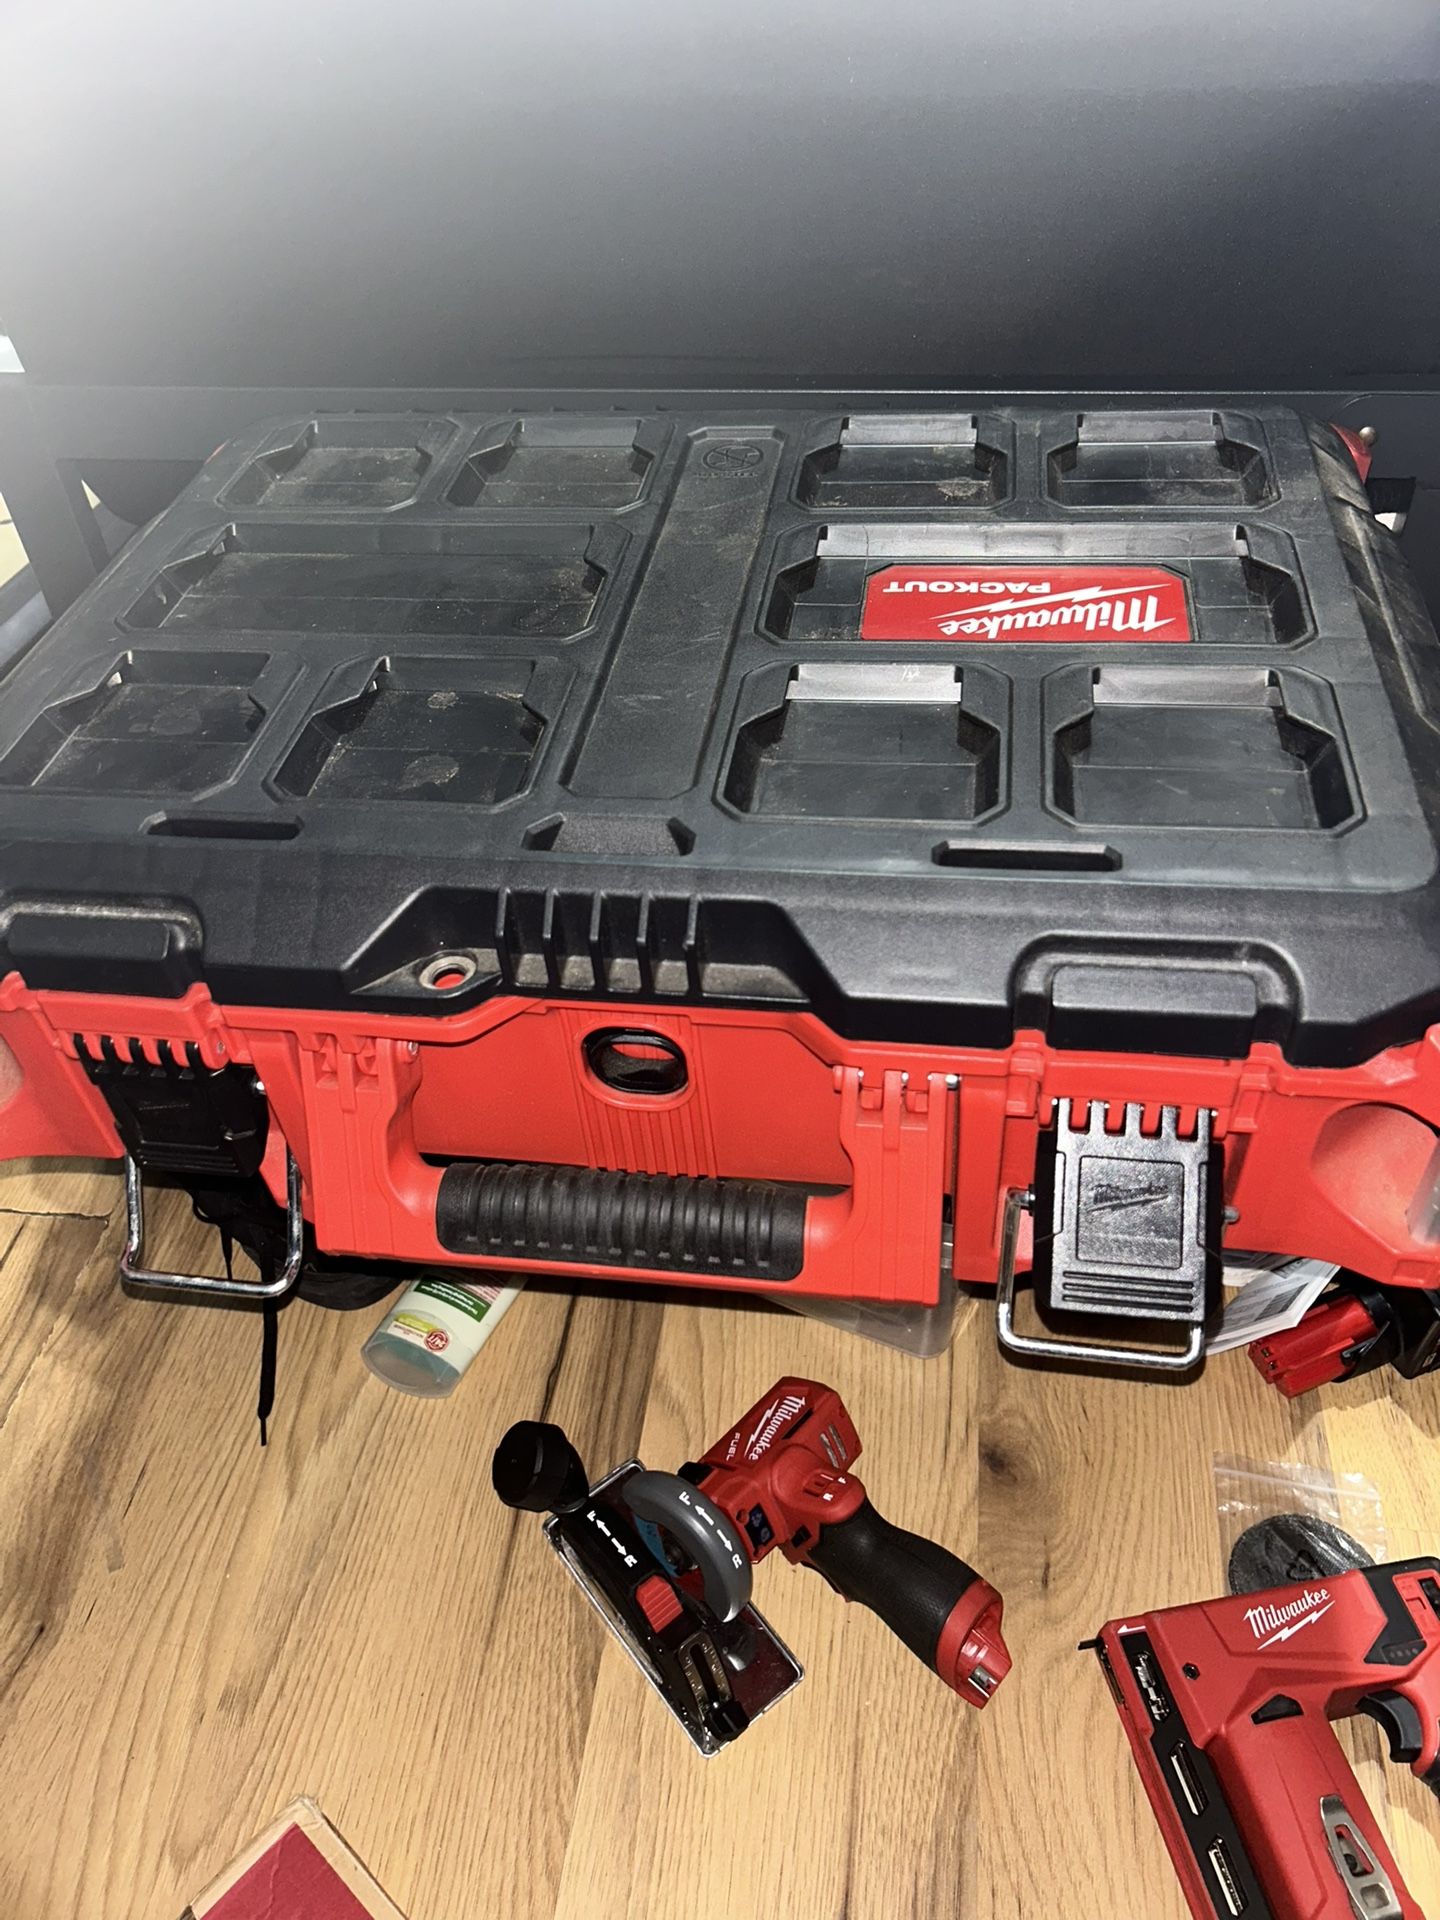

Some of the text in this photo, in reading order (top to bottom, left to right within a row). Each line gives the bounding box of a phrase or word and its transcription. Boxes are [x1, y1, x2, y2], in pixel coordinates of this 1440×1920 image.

[882, 580, 1051, 594] PACKOUT
[936, 594, 1177, 639] Milwaukee
[726, 1432, 741, 1461] FUEL
[748, 1395, 806, 1460] Milwaukee
[822, 1492, 834, 1501] R
[586, 1510, 638, 1568] F R
[678, 1491, 743, 1569] F R
[1242, 1588, 1331, 1639] Milwaukee
